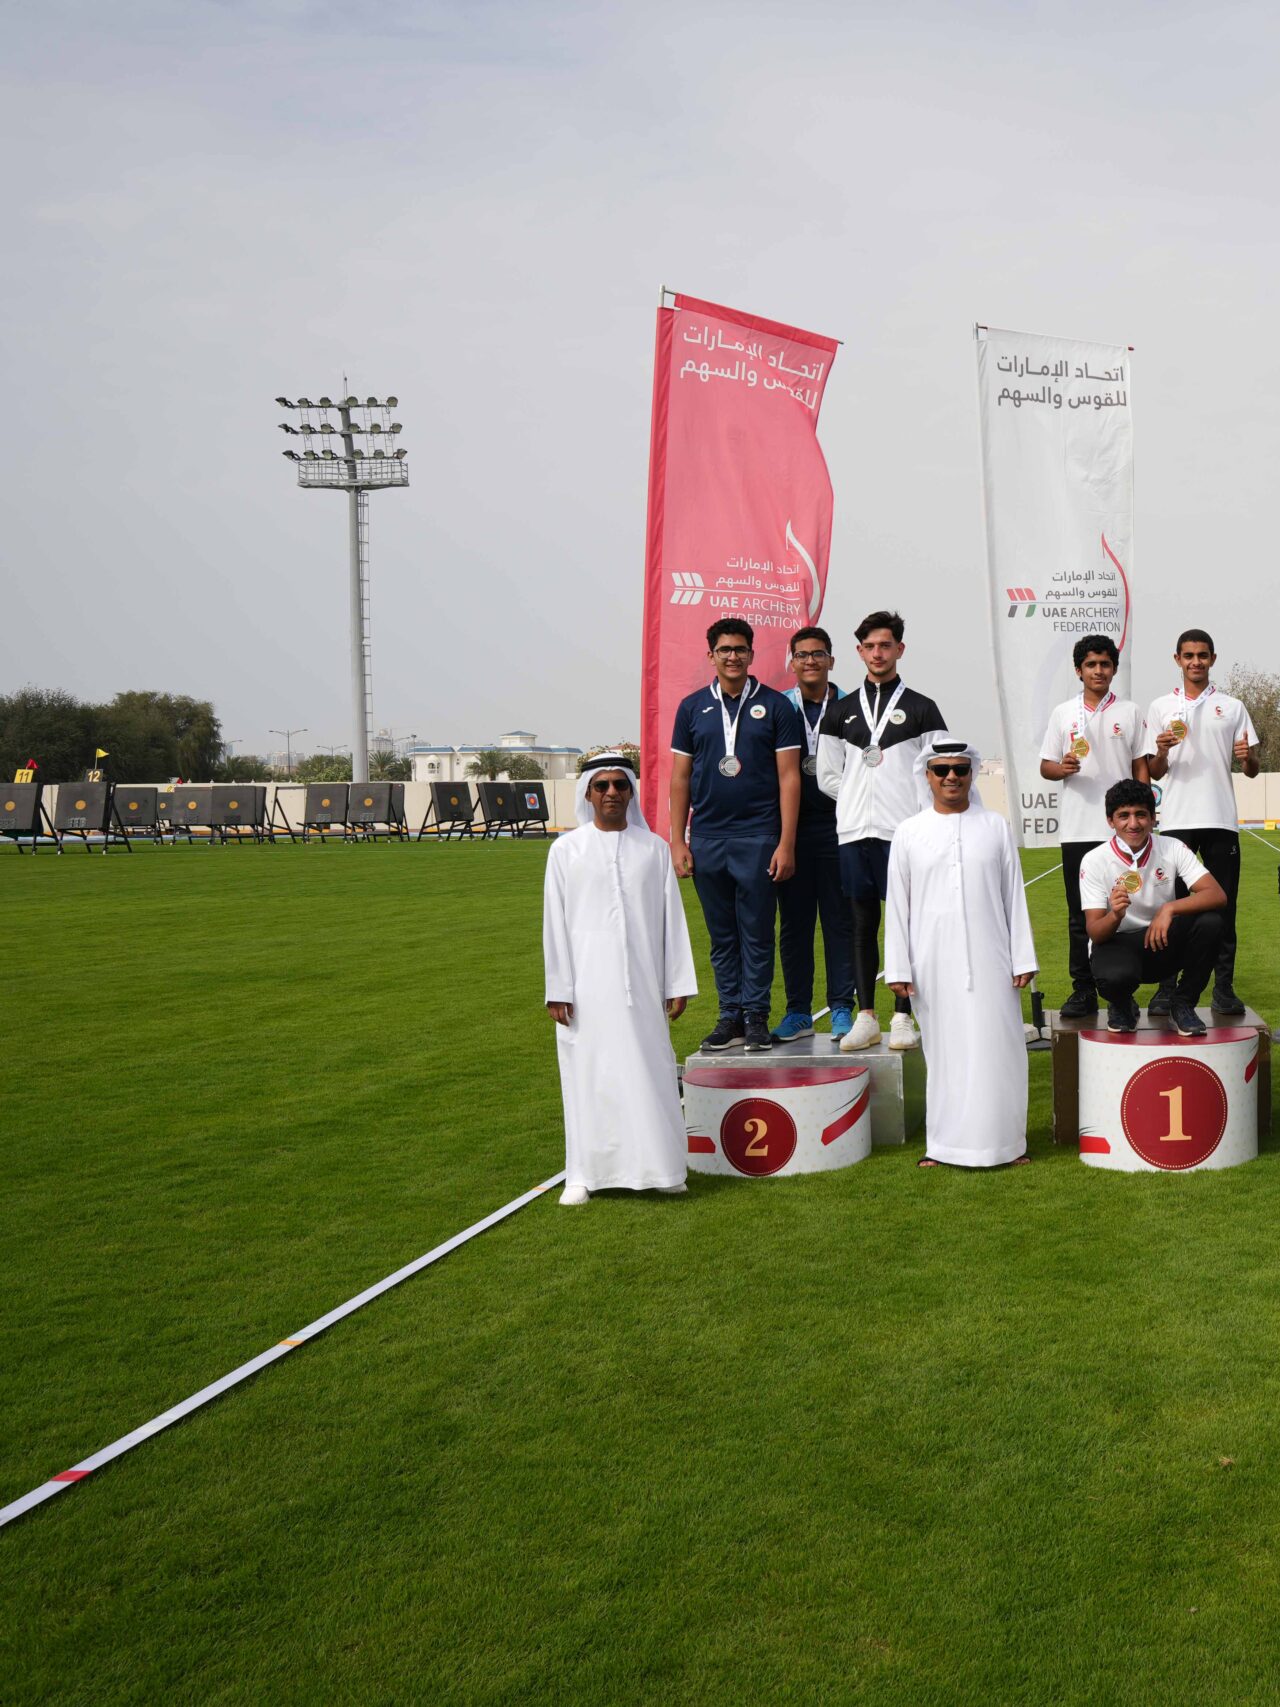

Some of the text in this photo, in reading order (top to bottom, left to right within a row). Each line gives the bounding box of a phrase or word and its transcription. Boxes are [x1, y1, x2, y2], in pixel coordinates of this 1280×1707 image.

[680, 358, 757, 387] والسهم
[768, 352, 825, 382] اتحاد
[997, 355, 1125, 383] اتحاد الإمارات
[997, 386, 1127, 410] للقوس والسهم
[776, 564, 800, 575] اتحاد
[1098, 571, 1116, 581] اتحاد
[715, 575, 800, 593] للقوس والسهم
[1045, 587, 1118, 600] للقوس والسهم
[709, 595, 801, 616] UAE ARCHERY
[1042, 607, 1120, 618] UAE ARCHERY
[1053, 621, 1121, 633] FEDERATION
[18, 771, 31, 782] 11
[87, 770, 101, 783] 12
[1021, 792, 1058, 809] UAE
[1159, 1085, 1193, 1141] 1
[743, 1118, 769, 1157] 2
